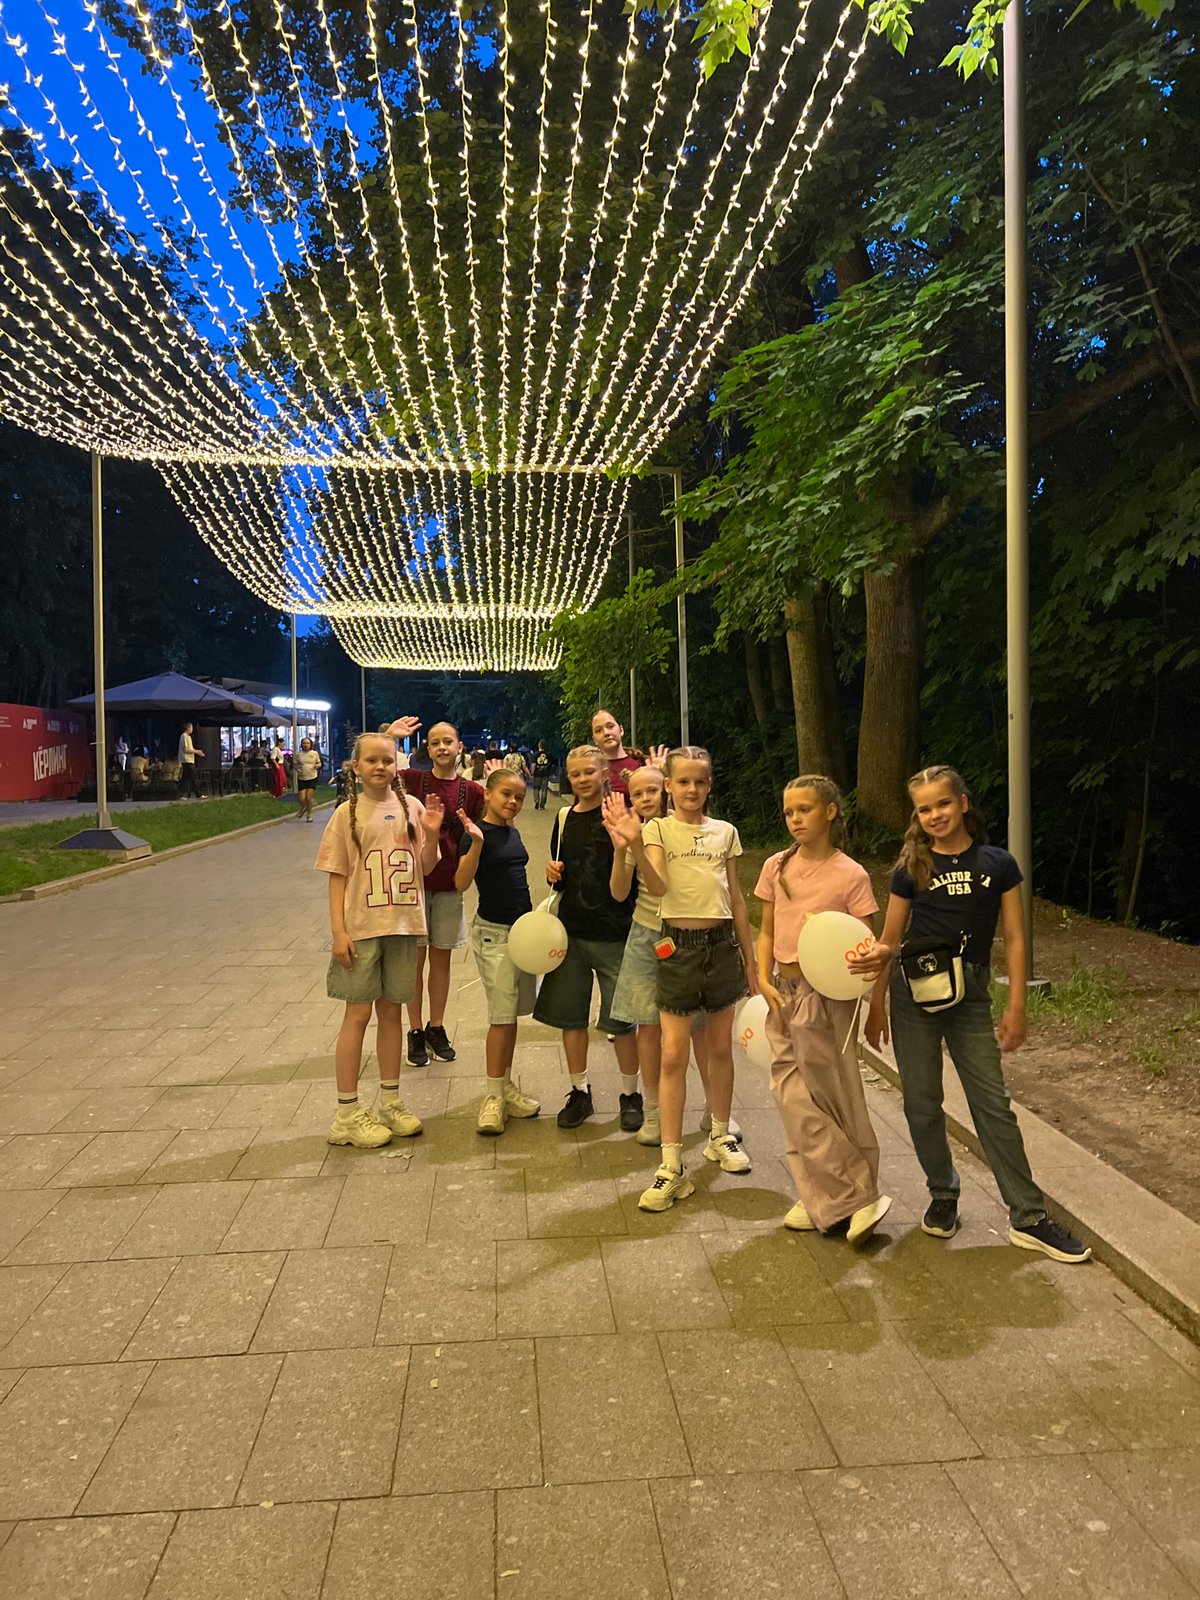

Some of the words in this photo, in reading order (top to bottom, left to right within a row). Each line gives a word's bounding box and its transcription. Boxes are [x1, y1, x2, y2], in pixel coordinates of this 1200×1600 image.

[33, 745, 67, 781] КЁРЛИНГ
[364, 848, 418, 907] 12
[929, 871, 991, 891] ALIFORA
[946, 882, 972, 895] USA
